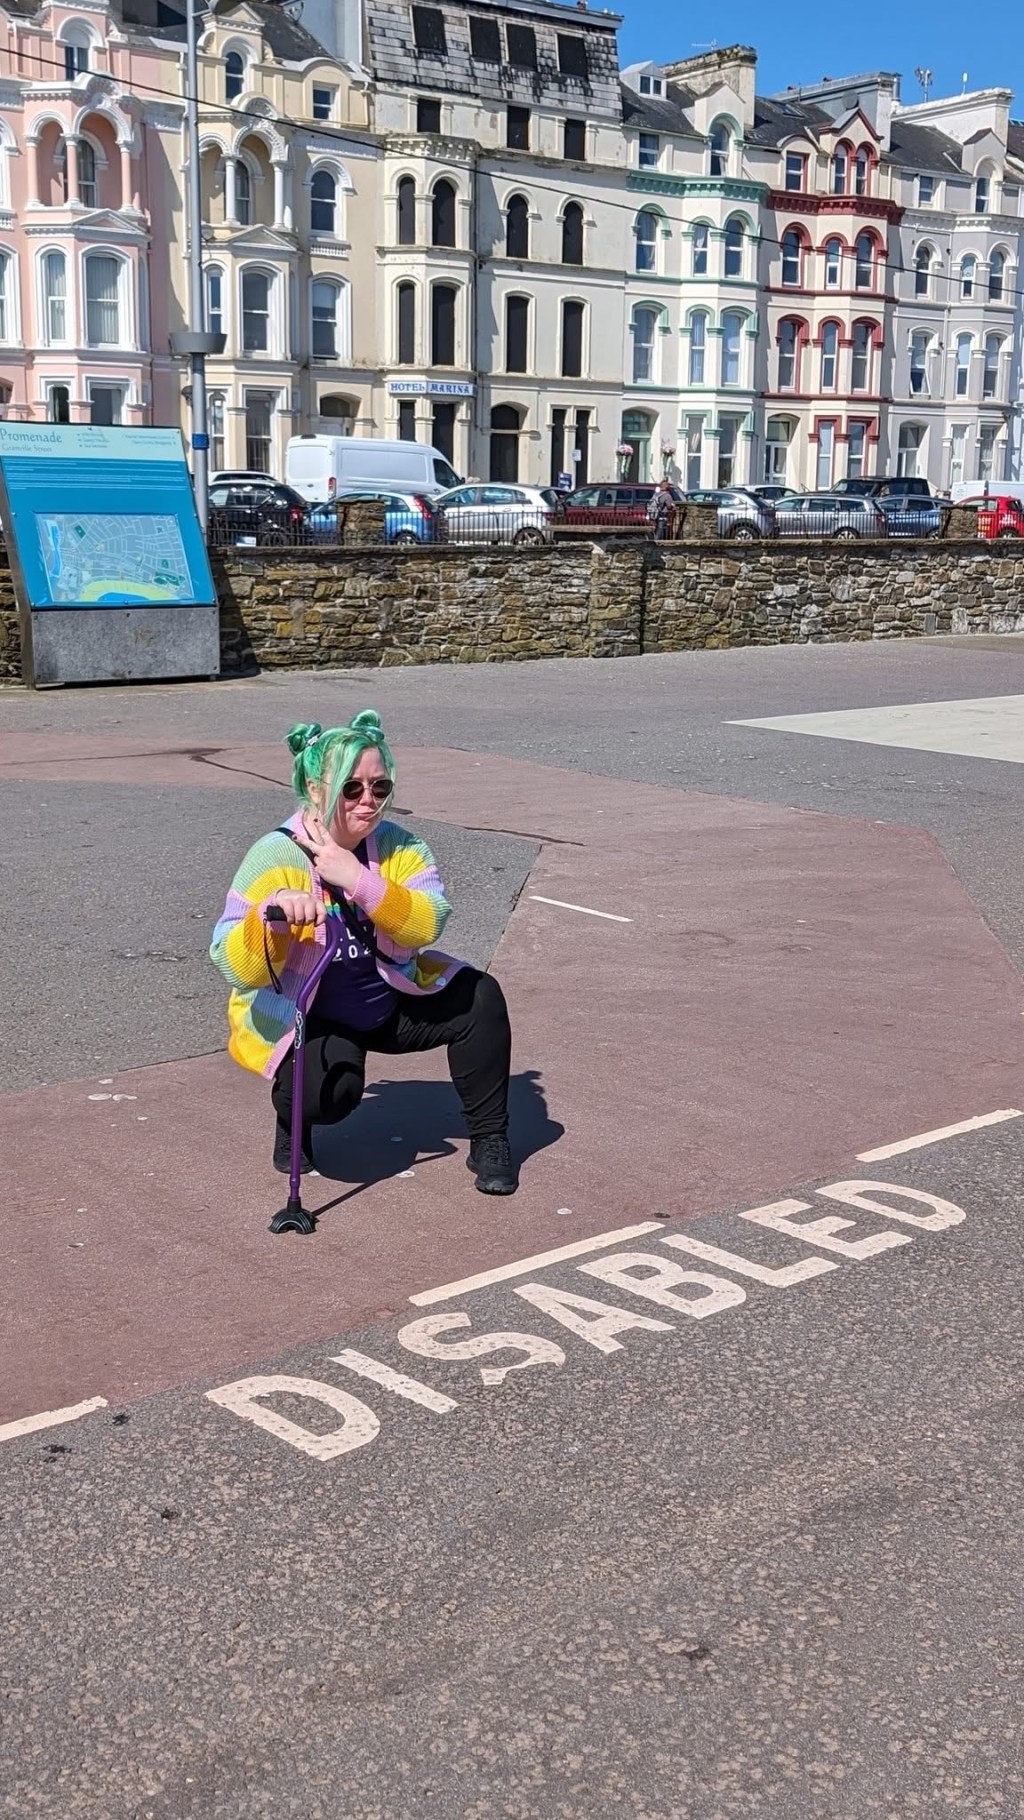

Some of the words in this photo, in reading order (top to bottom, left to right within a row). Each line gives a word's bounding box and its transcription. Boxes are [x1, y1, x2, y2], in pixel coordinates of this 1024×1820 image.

[390, 382, 425, 392] HOTEL
[430, 383, 470, 394] MARINA
[0, 427, 63, 443] Promenade
[203, 1180, 967, 1462] DISABLED
